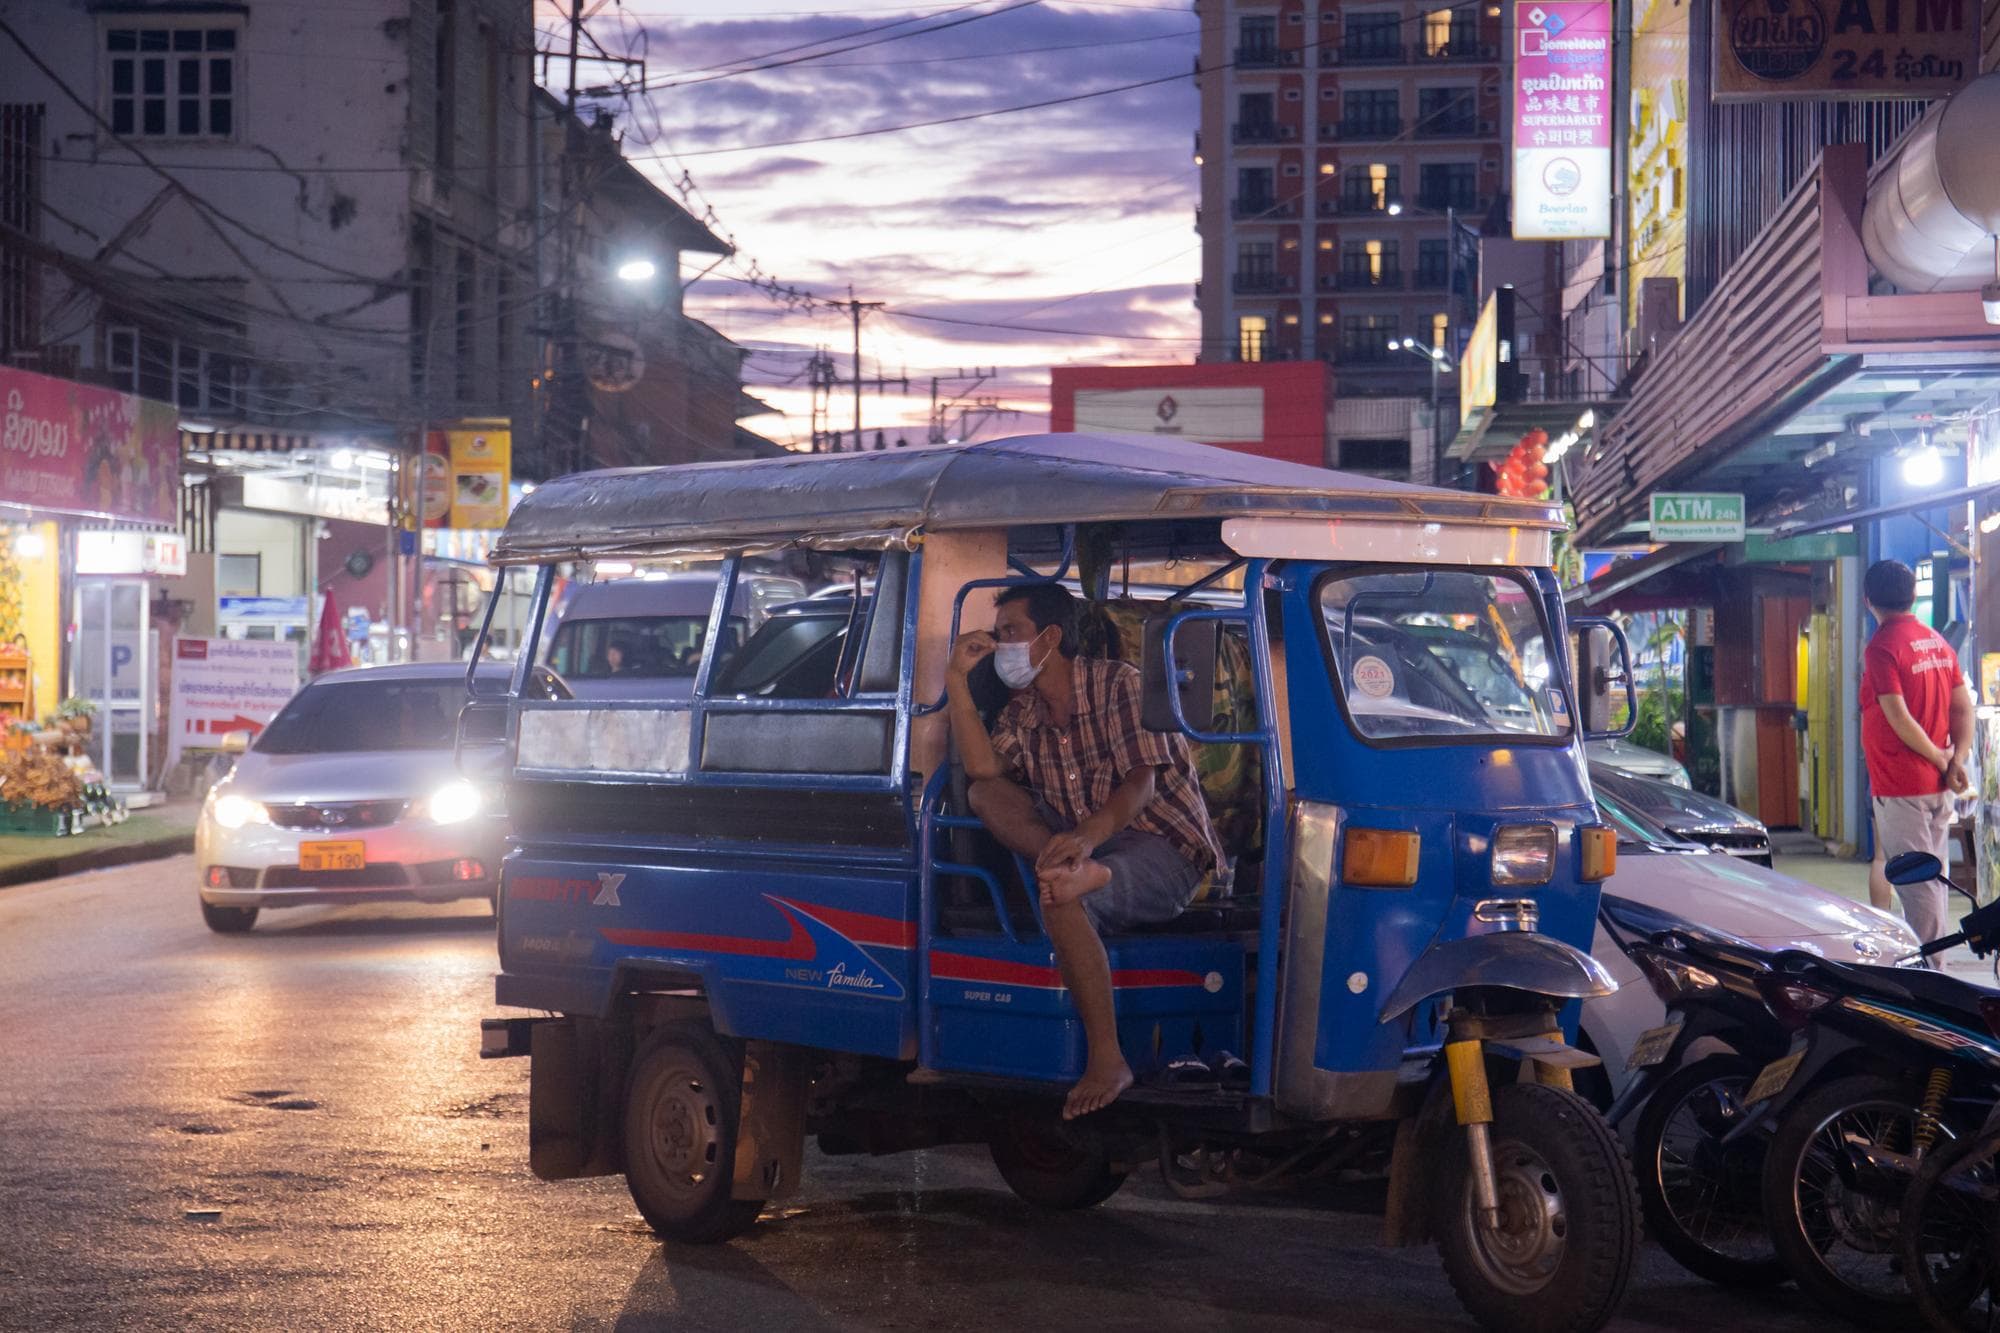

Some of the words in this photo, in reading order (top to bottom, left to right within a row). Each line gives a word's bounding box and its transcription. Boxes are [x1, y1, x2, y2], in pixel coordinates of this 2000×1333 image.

[1831, 49, 1887, 80] 24
[1522, 114, 1603, 126] SUPERMARKET
[1661, 499, 1712, 520] ATM
[1716, 509, 1737, 520] 24h
[111, 645, 132, 677] P
[1360, 671, 1385, 679] 2021
[785, 968, 823, 981] NEW
[826, 962, 885, 988] familia
[964, 991, 991, 1000] SUPER
[994, 993, 1011, 1003] CAB
